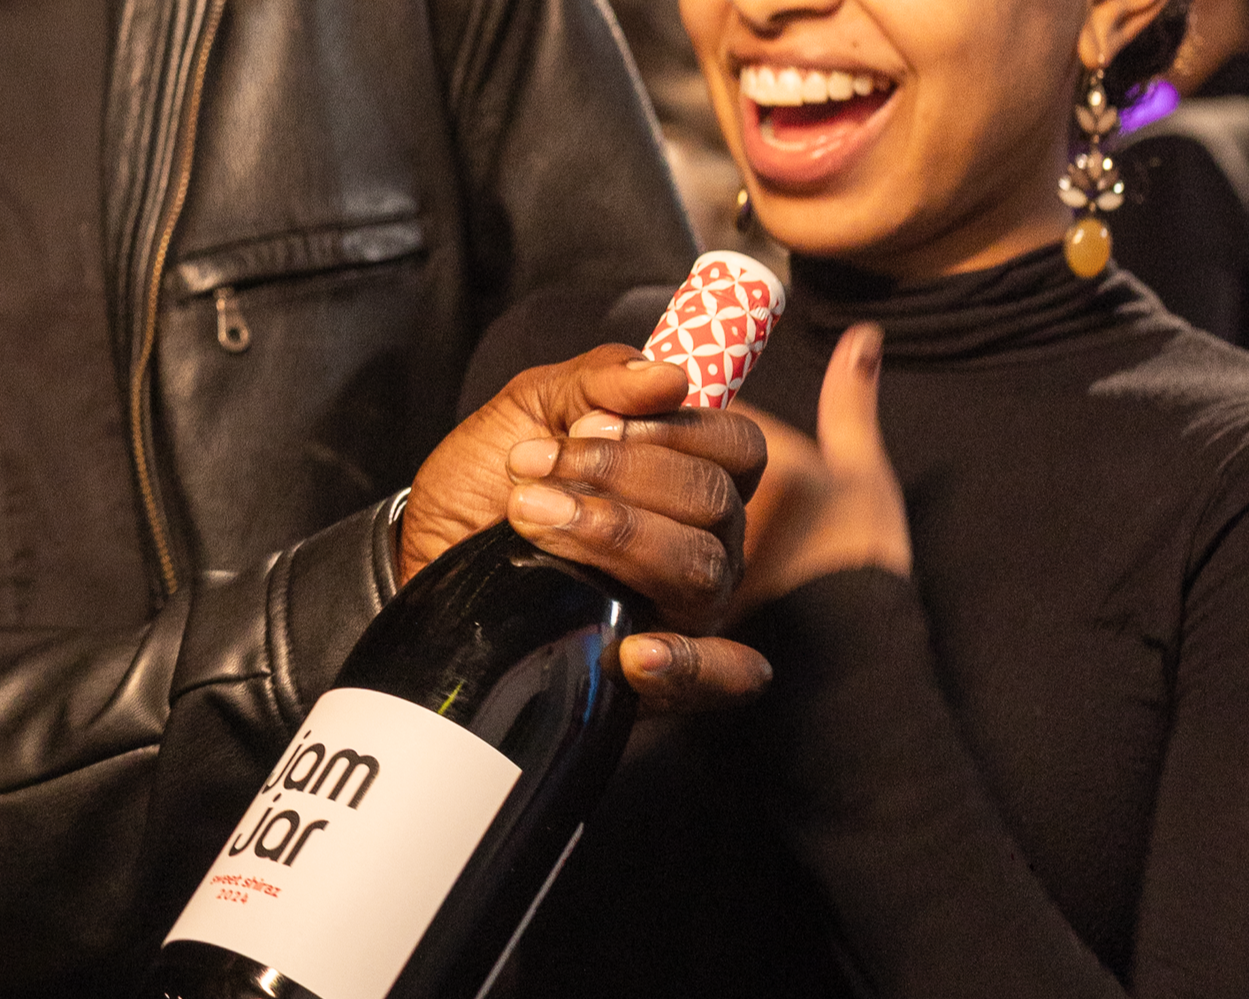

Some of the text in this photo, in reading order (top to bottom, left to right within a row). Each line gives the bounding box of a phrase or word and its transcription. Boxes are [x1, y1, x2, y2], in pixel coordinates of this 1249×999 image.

[262, 730, 380, 810] jam
[228, 793, 330, 868] jar
[216, 888, 248, 904] 2024
[241, 876, 281, 898] shiraz
